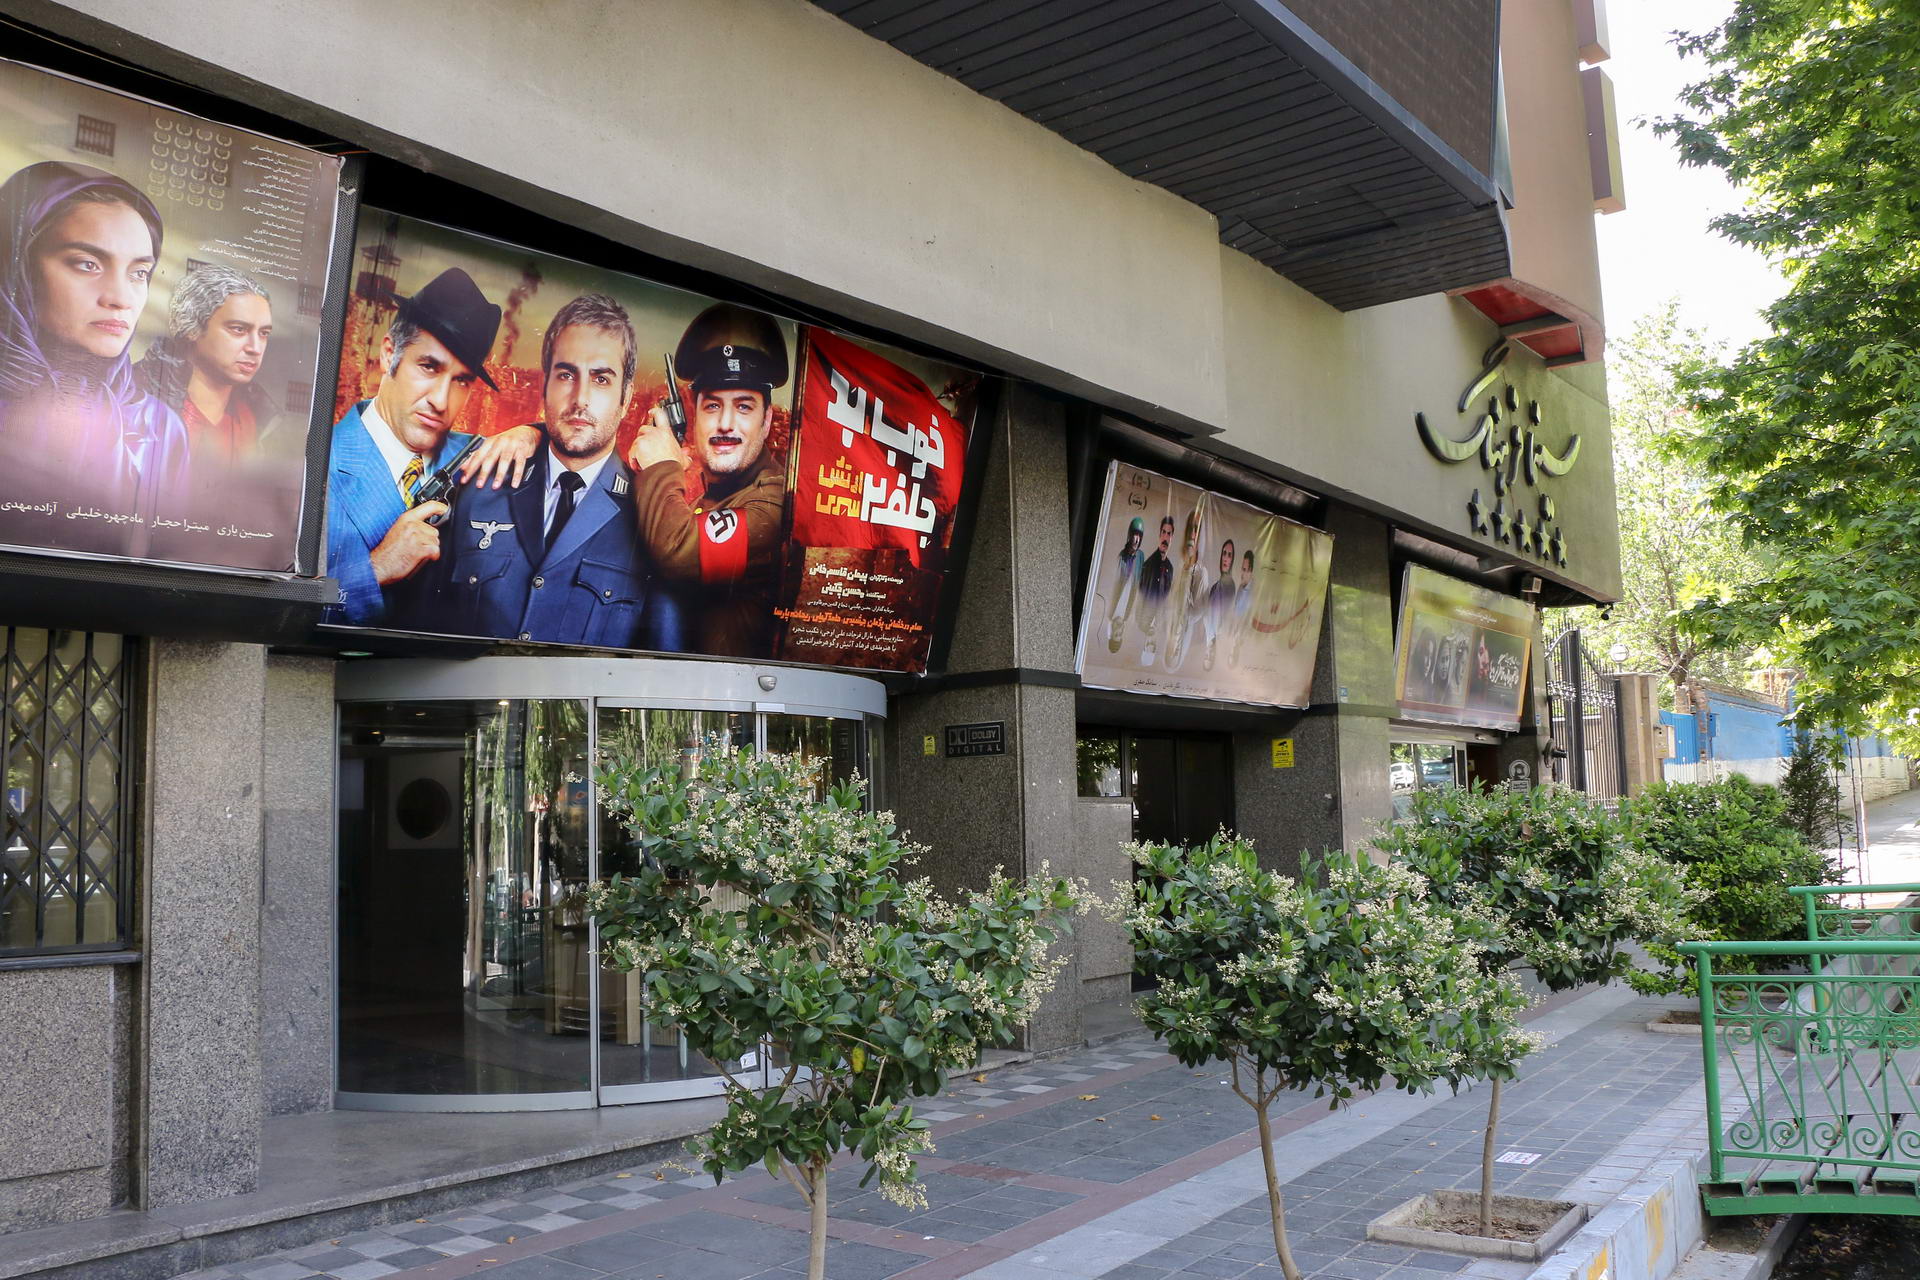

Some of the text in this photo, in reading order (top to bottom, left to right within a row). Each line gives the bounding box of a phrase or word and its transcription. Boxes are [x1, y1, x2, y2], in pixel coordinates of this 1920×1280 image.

[826, 366, 945, 479] خوب بد
[817, 455, 864, 494] ارتش
[0, 500, 32, 513] مهدی
[33, 501, 59, 516] آزاده
[815, 492, 861, 519] سری
[66, 505, 104, 520] خلیلی
[152, 515, 182, 529] حجار
[183, 518, 211, 532] میترا
[216, 524, 238, 537] یاری
[238, 528, 275, 539] حسین
[847, 568, 869, 585] پیمان
[821, 582, 843, 599] چگینی
[842, 587, 866, 599] محسن
[773, 607, 790, 622] پارسا
[842, 614, 867, 627] جمشیدی
[866, 616, 885, 631] پژمان
[884, 618, 910, 630] درخشانی
[909, 622, 924, 633] سام
[834, 629, 846, 638] علی
[820, 638, 836, 647] گوهر
[854, 641, 870, 651] فرهاد
[869, 643, 891, 652] هنرمندی
[891, 644, 897, 652] با
[971, 729, 997, 740] DOLBY
[948, 744, 1001, 755] DIGITAL
